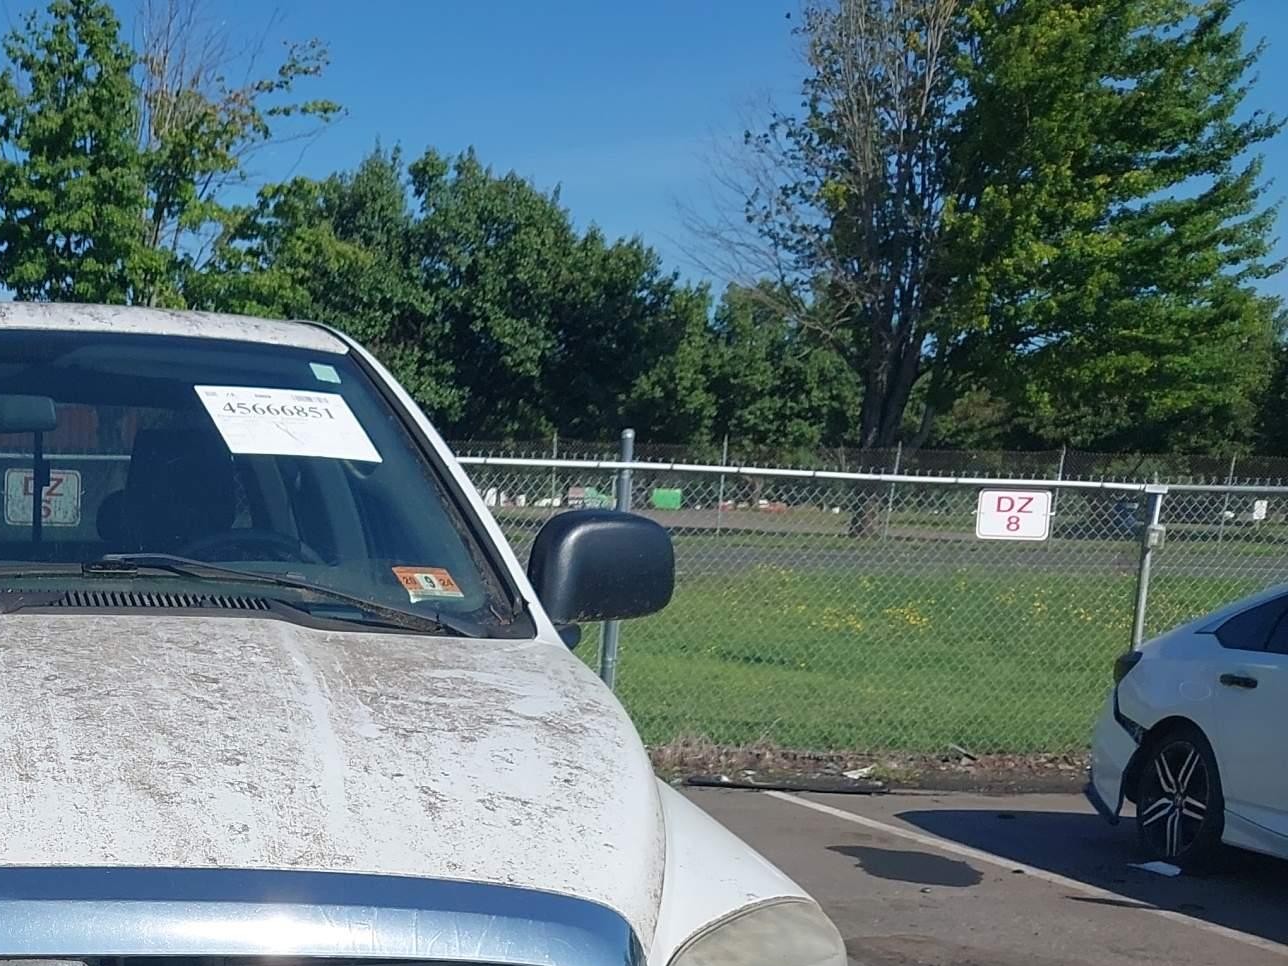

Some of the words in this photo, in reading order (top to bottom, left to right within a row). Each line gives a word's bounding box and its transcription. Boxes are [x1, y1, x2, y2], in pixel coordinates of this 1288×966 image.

[223, 401, 335, 420] 45666851
[996, 496, 1034, 513] DZ
[1006, 515, 1020, 532] 8
[423, 575, 436, 589] 9
